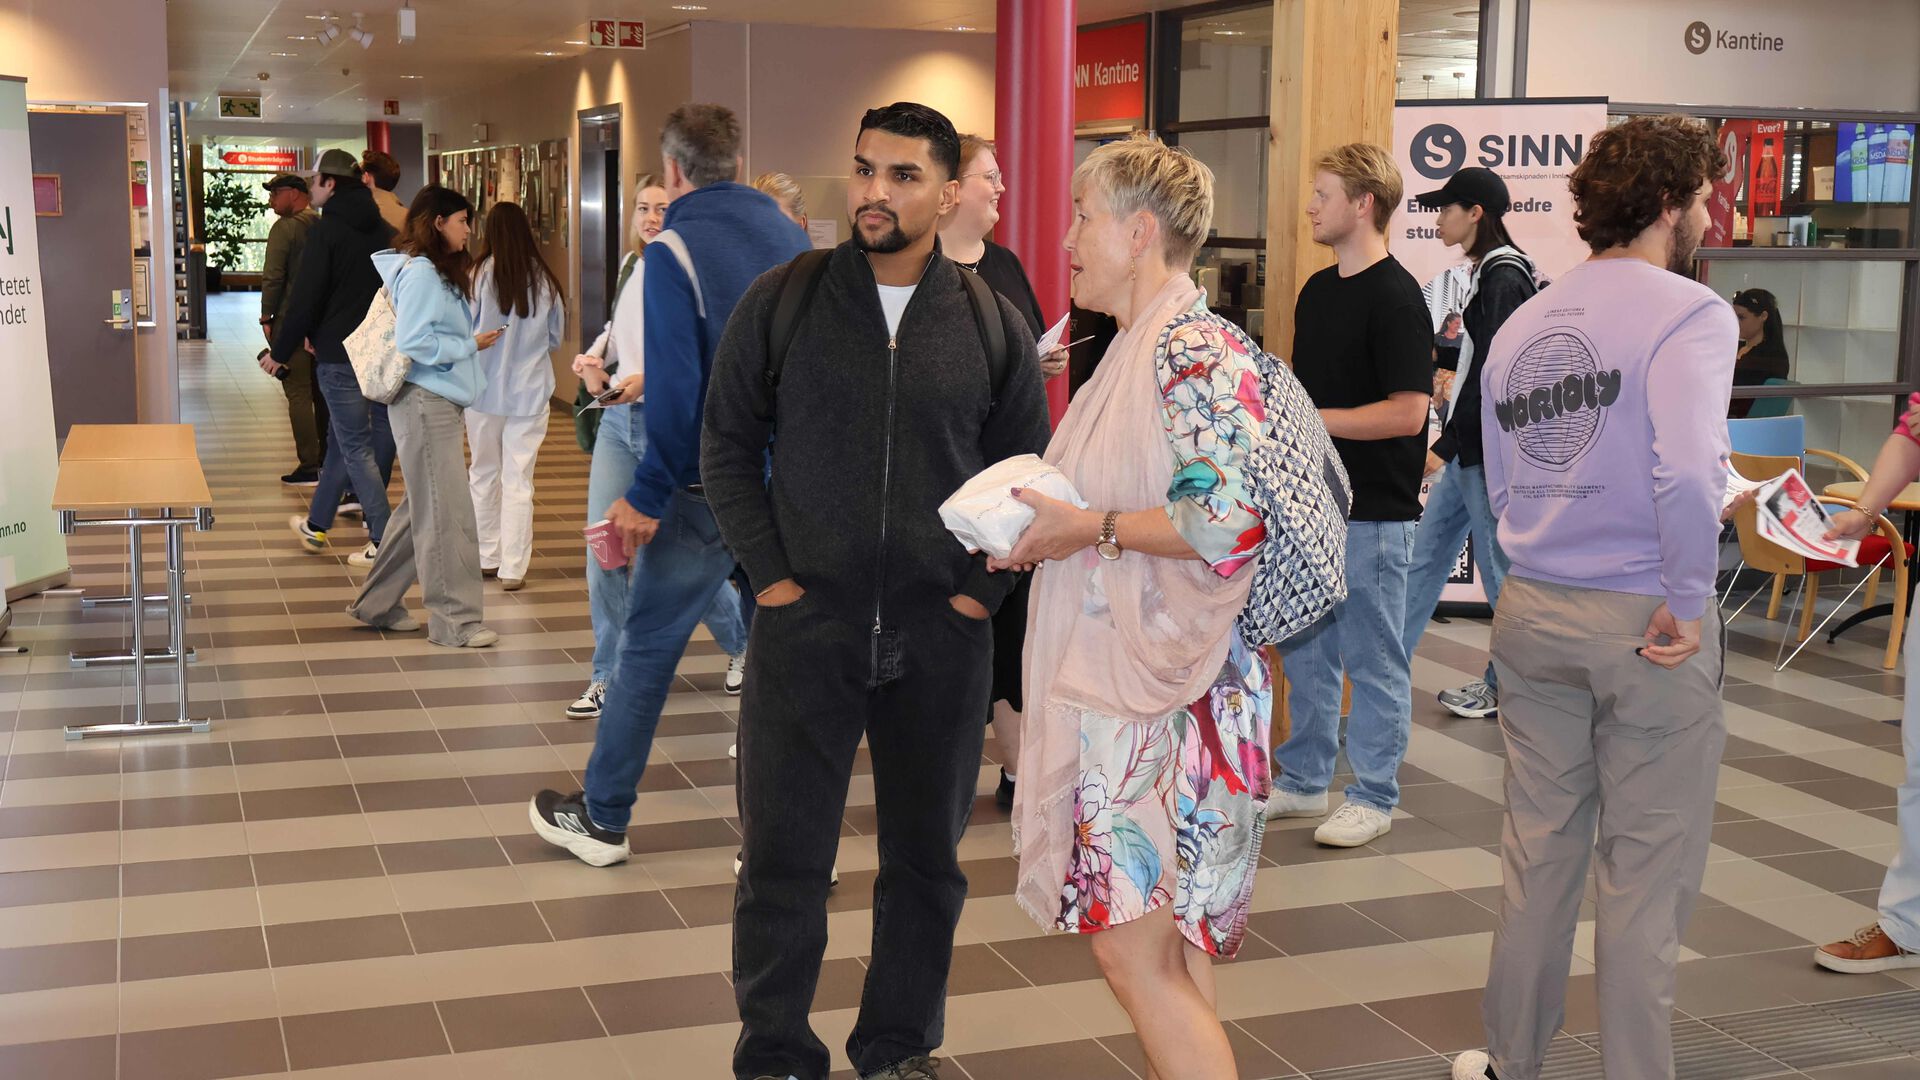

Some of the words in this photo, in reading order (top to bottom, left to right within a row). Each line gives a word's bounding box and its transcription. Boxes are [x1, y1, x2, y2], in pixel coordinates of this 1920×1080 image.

[1716, 30, 1784, 51] Kantine
[1094, 59, 1139, 86] Kantine
[1757, 124, 1781, 133] Ever?
[1478, 134, 1582, 167] SINN
